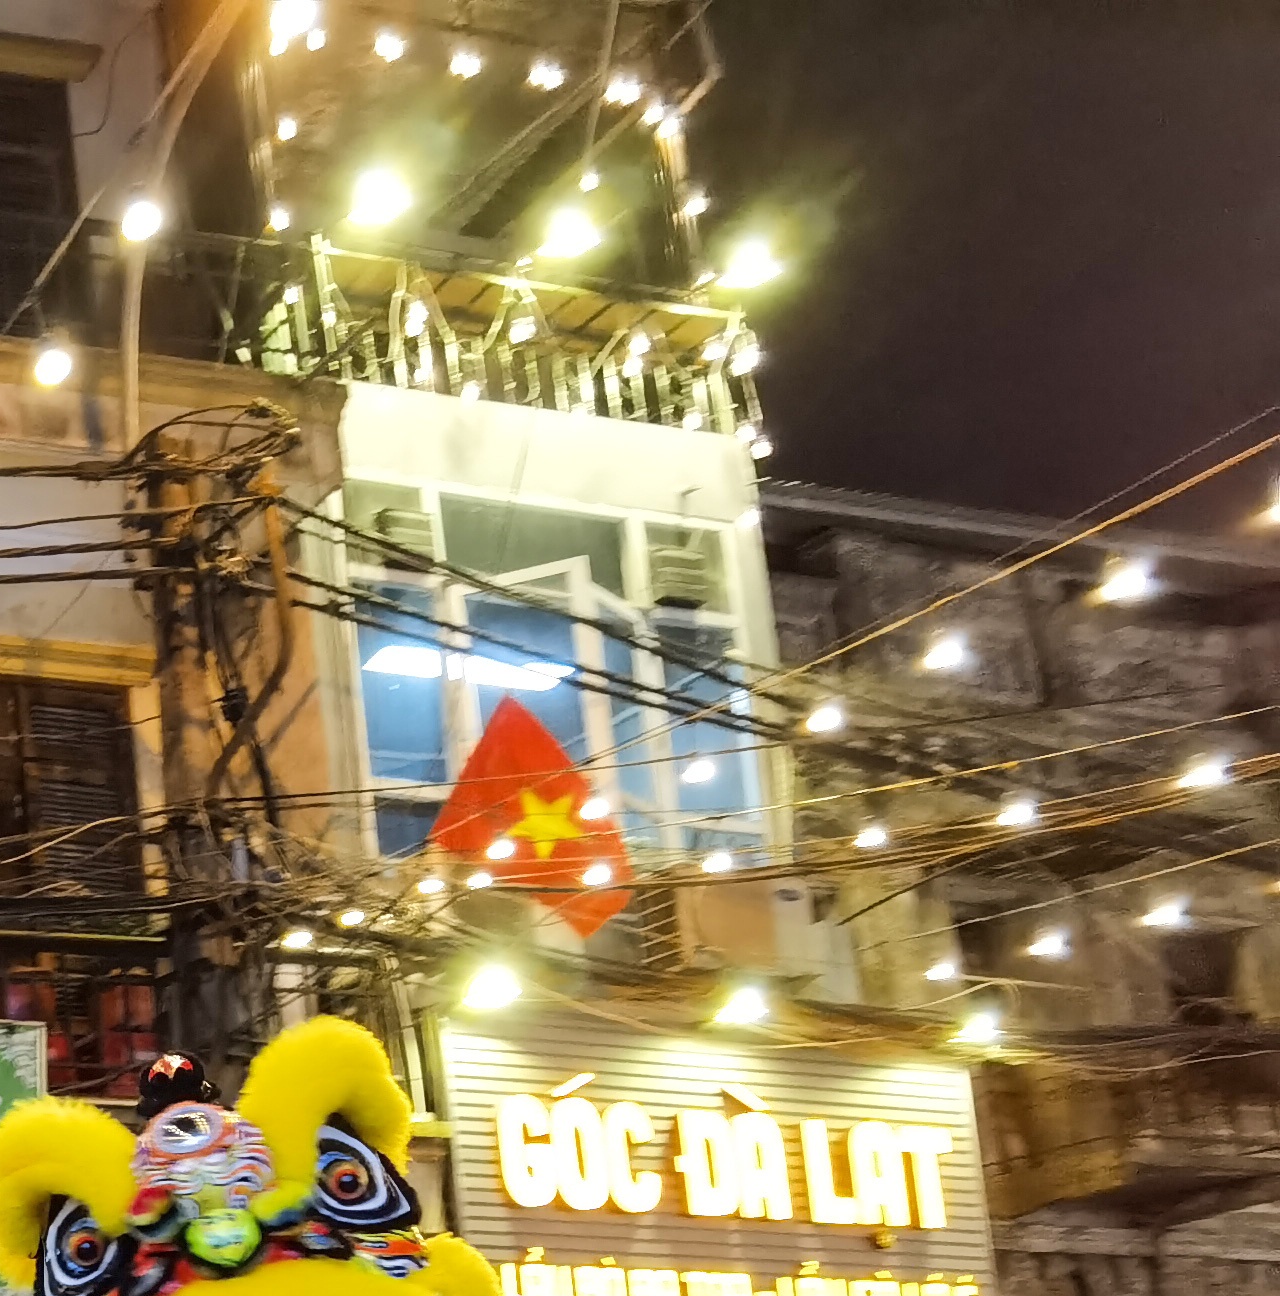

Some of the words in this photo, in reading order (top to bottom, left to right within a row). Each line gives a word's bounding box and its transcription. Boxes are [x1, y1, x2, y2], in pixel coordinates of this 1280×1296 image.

[496, 1072, 662, 1214] GÓC
[674, 1083, 794, 1221] ĐÀ
[800, 1119, 953, 1248] LẠT
